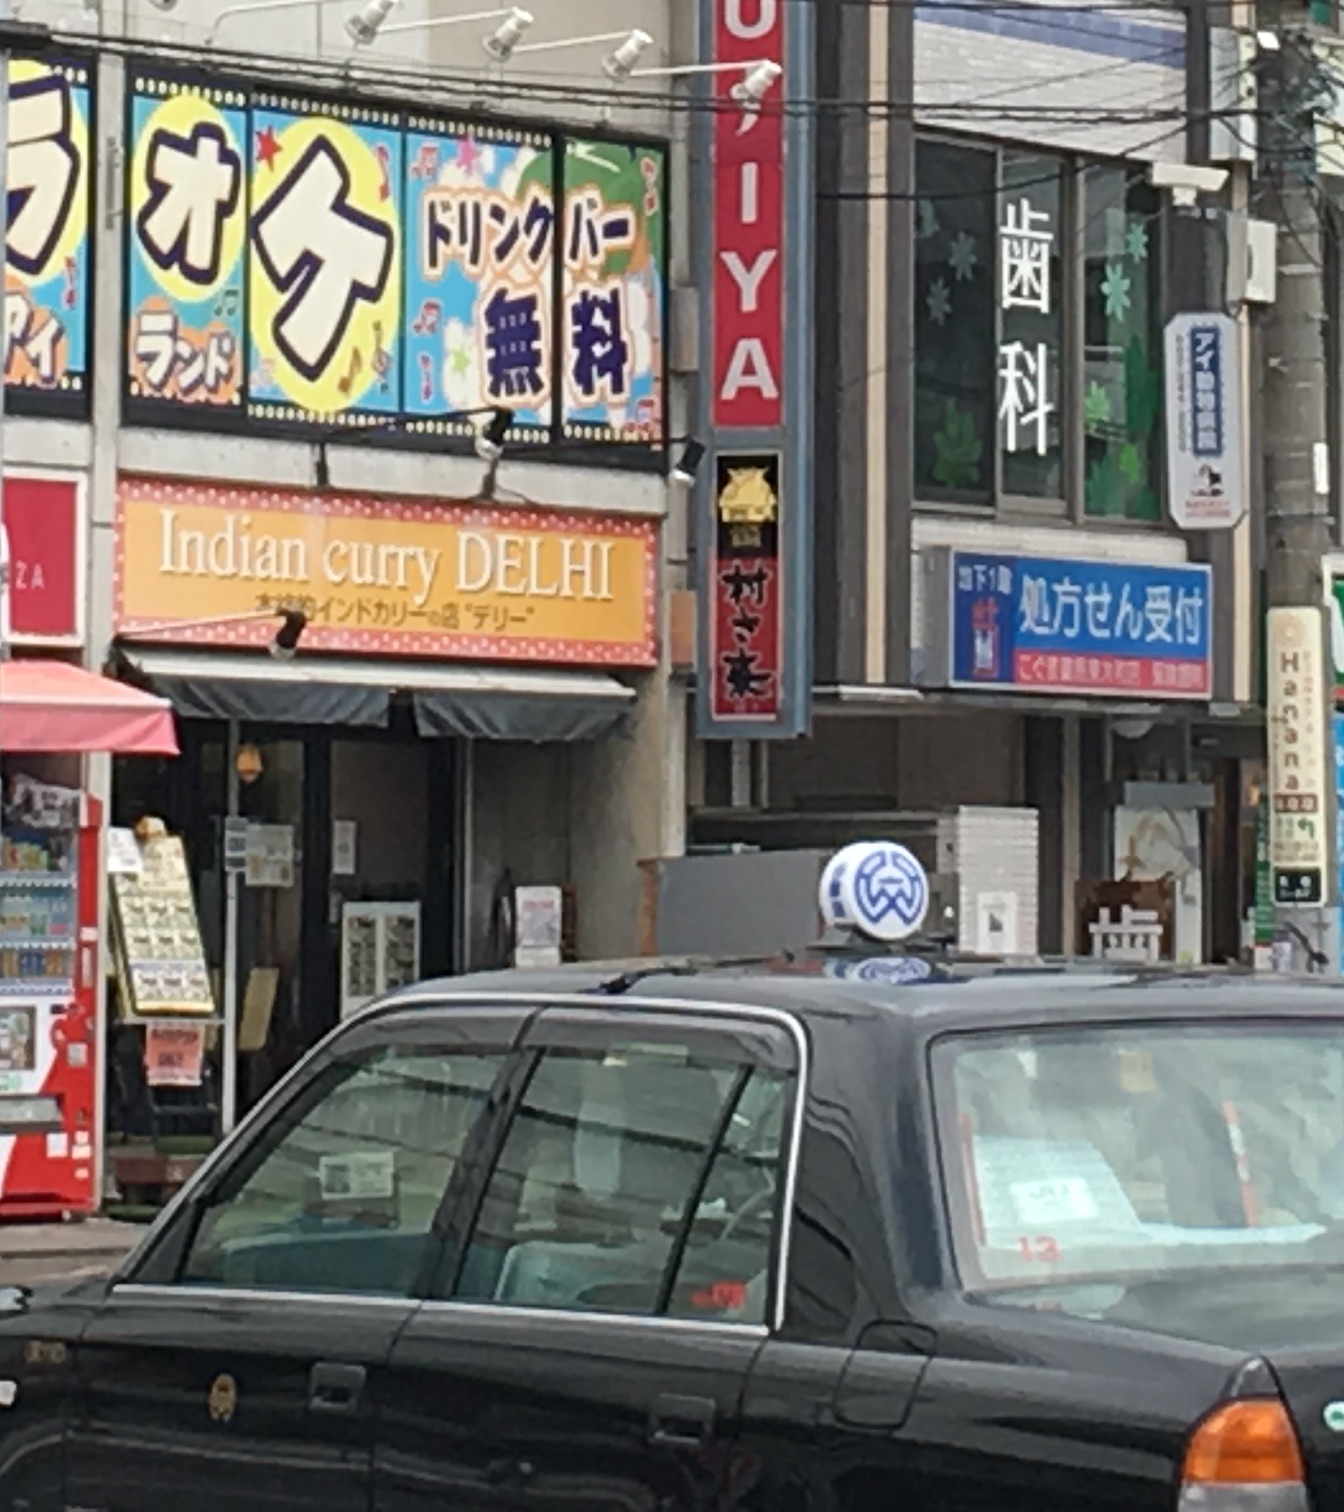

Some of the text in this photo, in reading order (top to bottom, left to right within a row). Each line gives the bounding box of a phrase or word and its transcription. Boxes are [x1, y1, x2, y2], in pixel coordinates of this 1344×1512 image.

[427, 194, 634, 270] ドリンクバー
[487, 287, 628, 397] 無料
[998, 198, 1054, 456] 歯科
[158, 509, 614, 605] Indian curry DELHI
[1019, 574, 1203, 645] 処方せん受付
